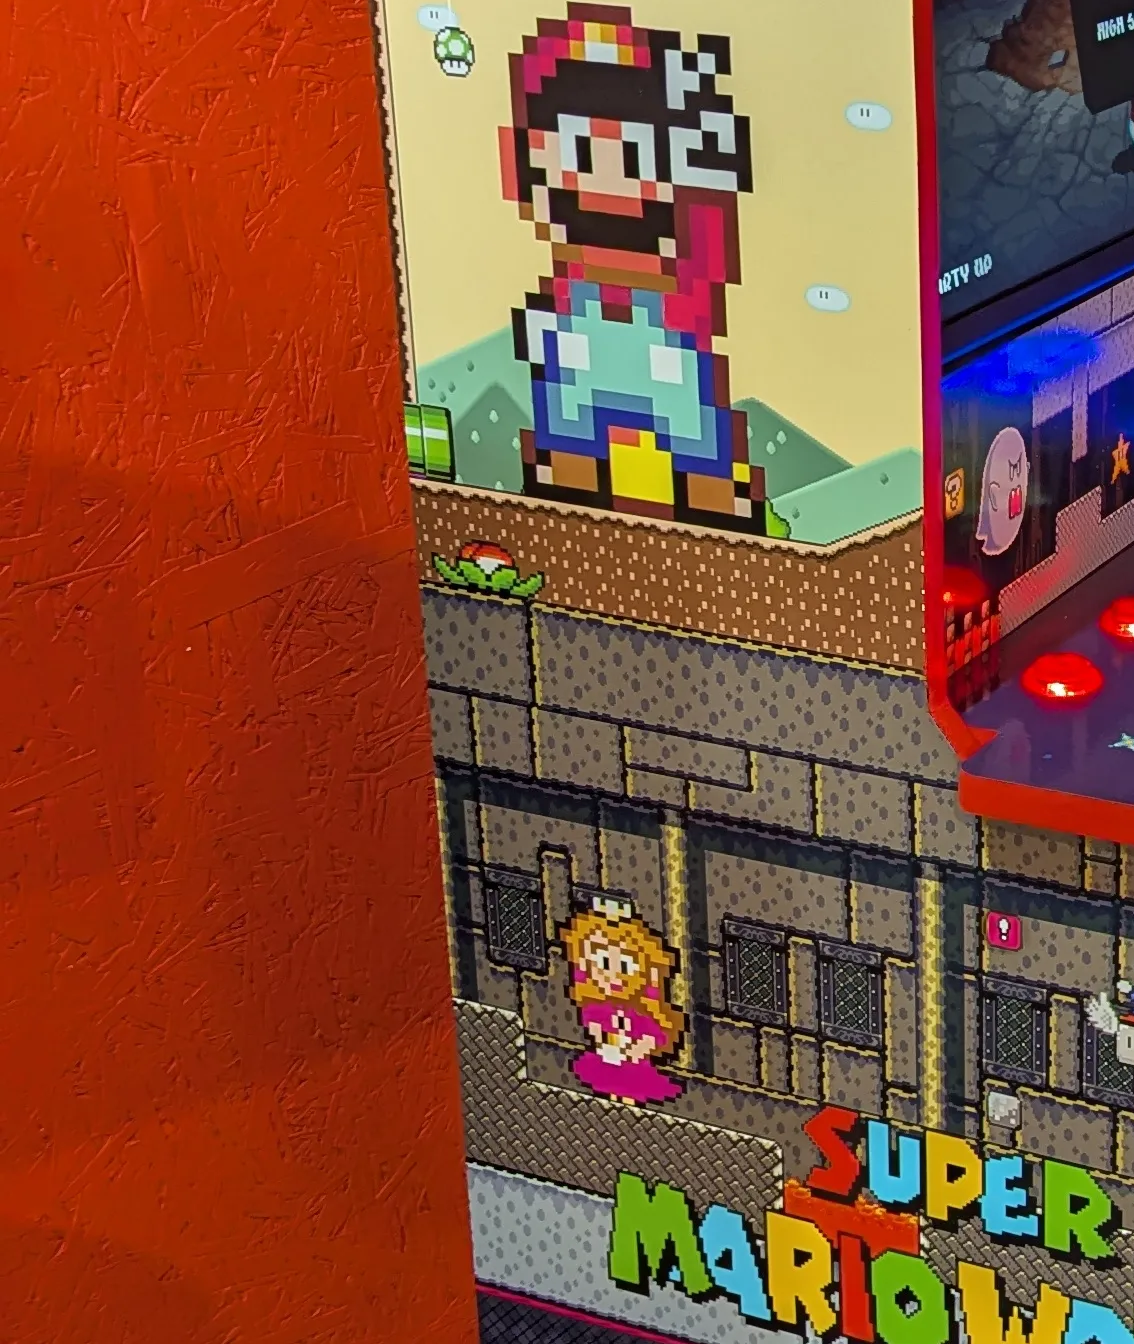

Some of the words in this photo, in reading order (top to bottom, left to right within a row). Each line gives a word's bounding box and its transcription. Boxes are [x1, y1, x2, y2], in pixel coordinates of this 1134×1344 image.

[1097, 16, 1125, 41] HIGH
[973, 253, 993, 278] UP
[803, 1106, 1117, 1261] SUPER
